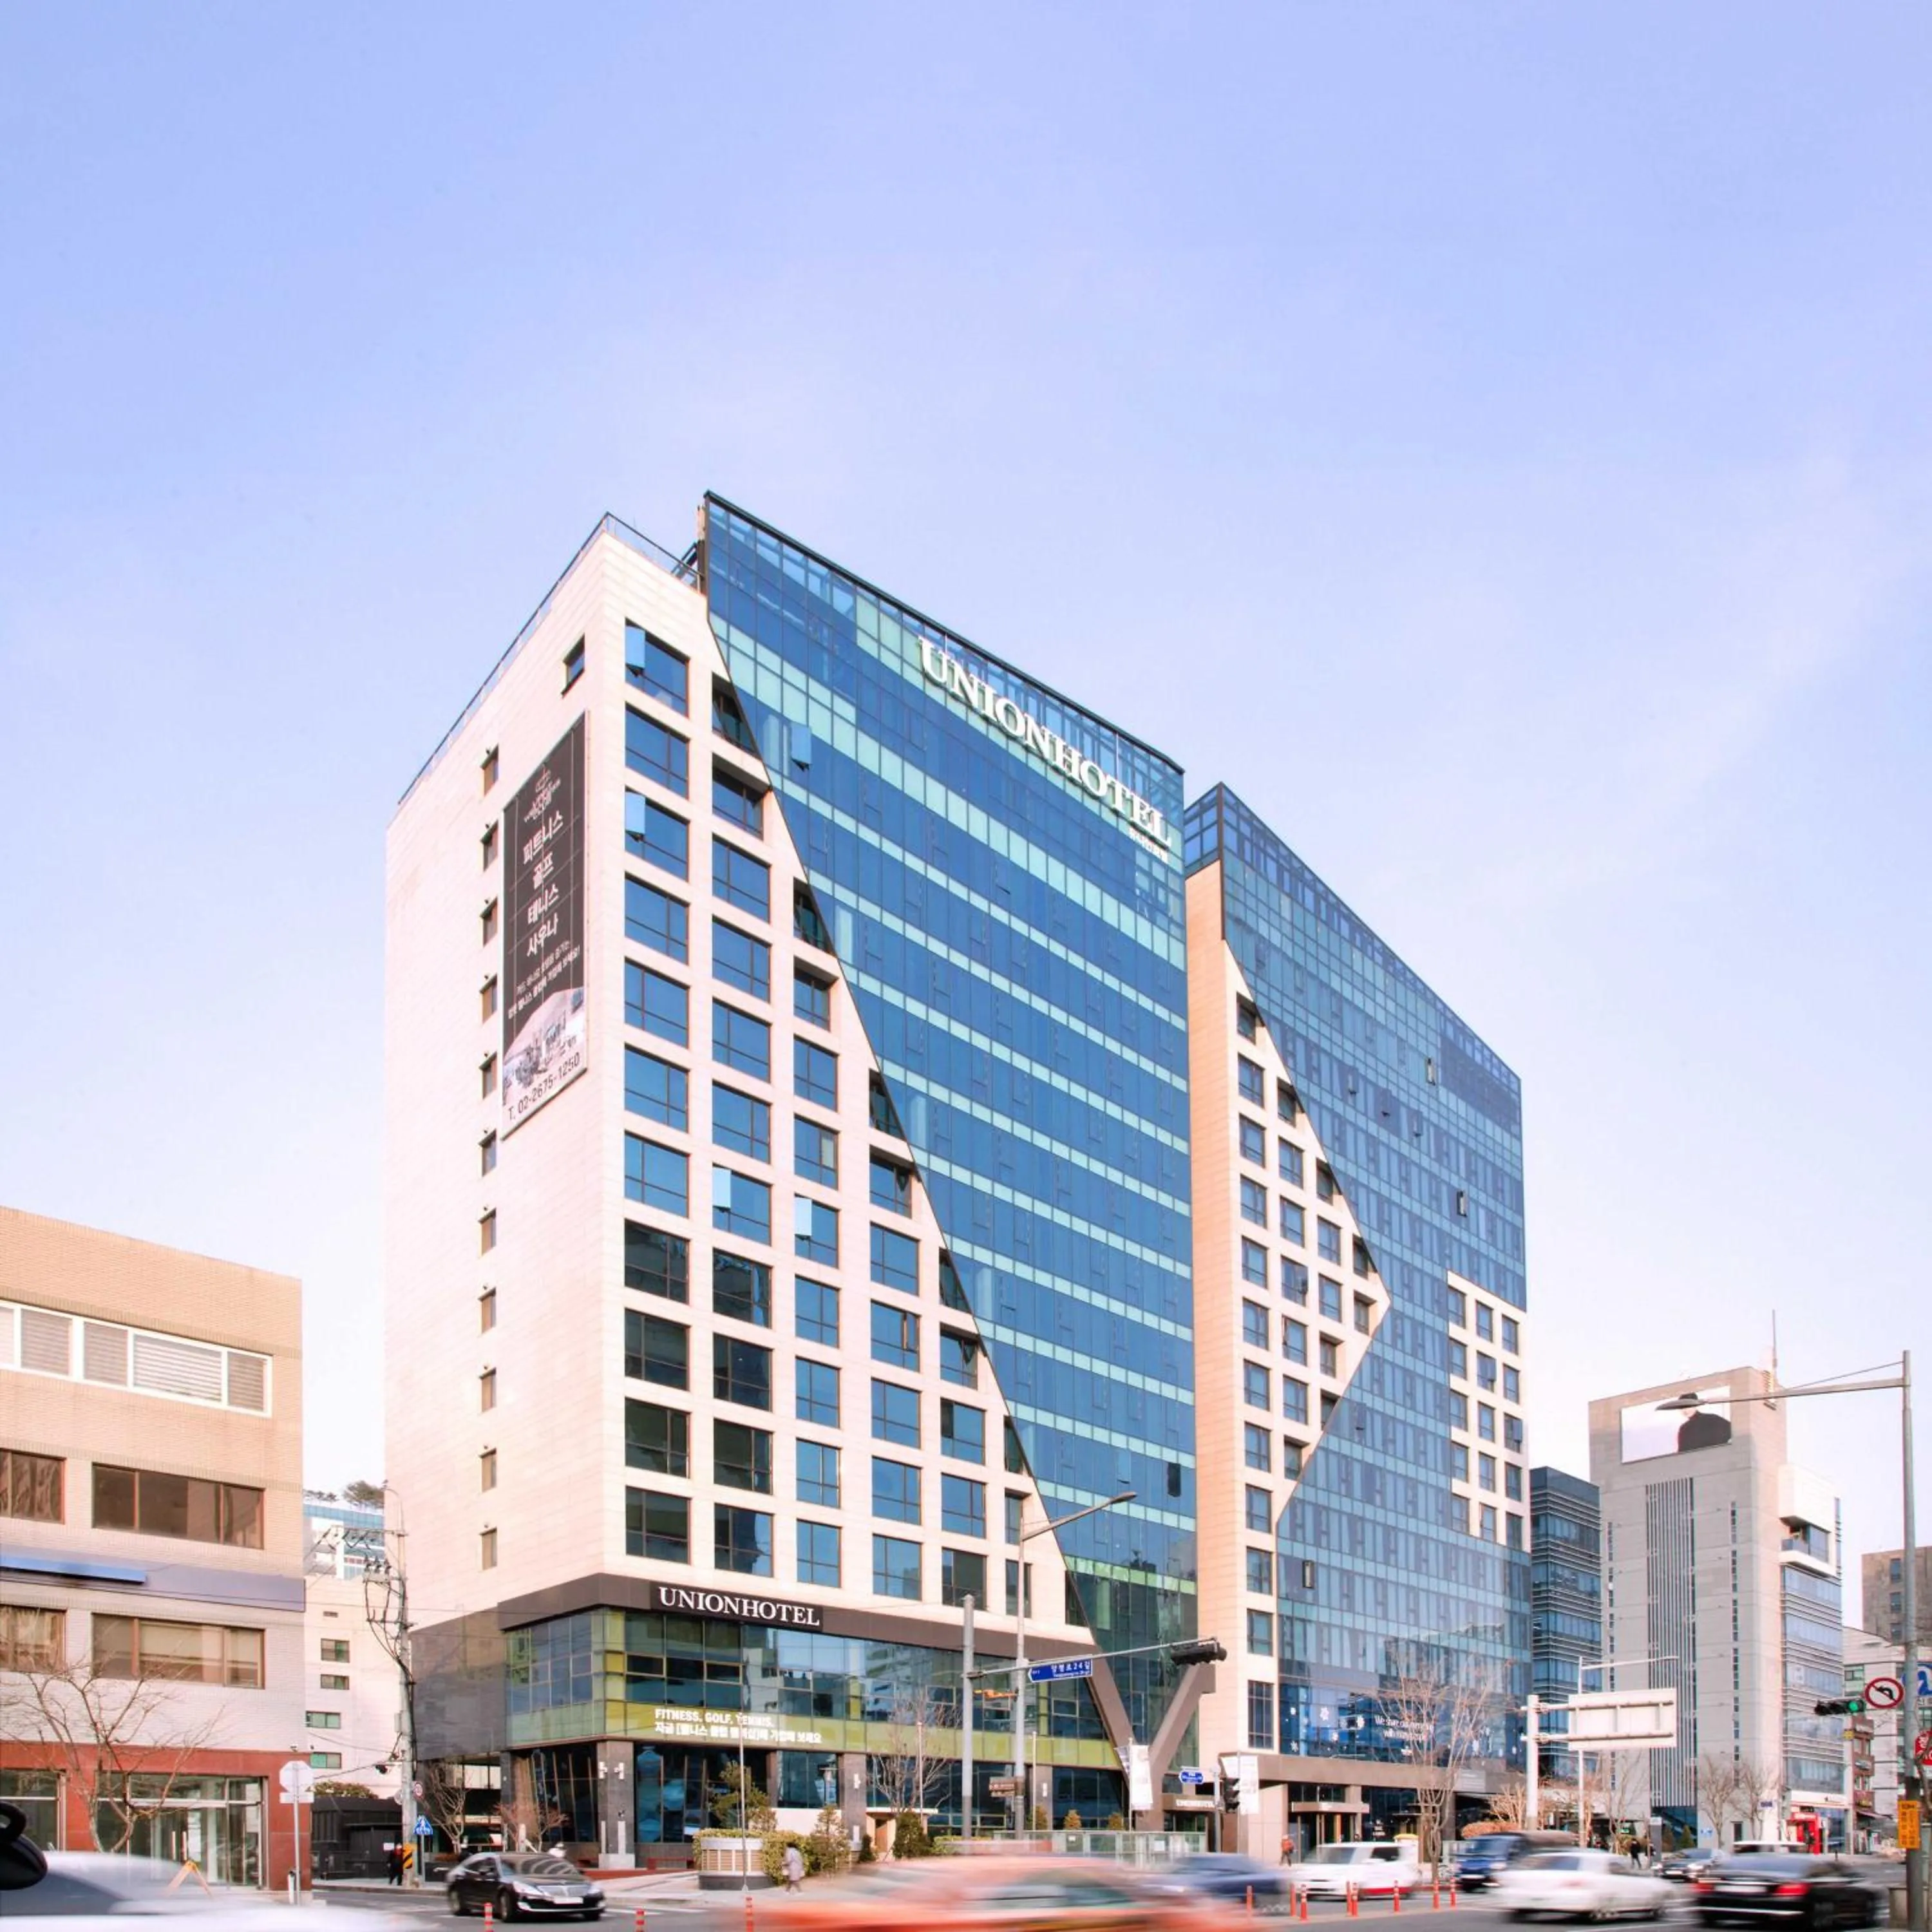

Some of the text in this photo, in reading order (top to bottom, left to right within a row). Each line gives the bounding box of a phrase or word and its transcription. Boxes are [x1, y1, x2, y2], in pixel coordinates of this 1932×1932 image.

[918, 636, 1171, 848] UNIONHOTEL
[523, 810, 564, 865] 피트니스
[533, 851, 554, 889] 골프
[528, 883, 559, 924] 테니스
[527, 912, 558, 957] 사우나
[659, 1586, 820, 1626] UNIONHOTEL
[705, 1712, 734, 1725] GOLF.
